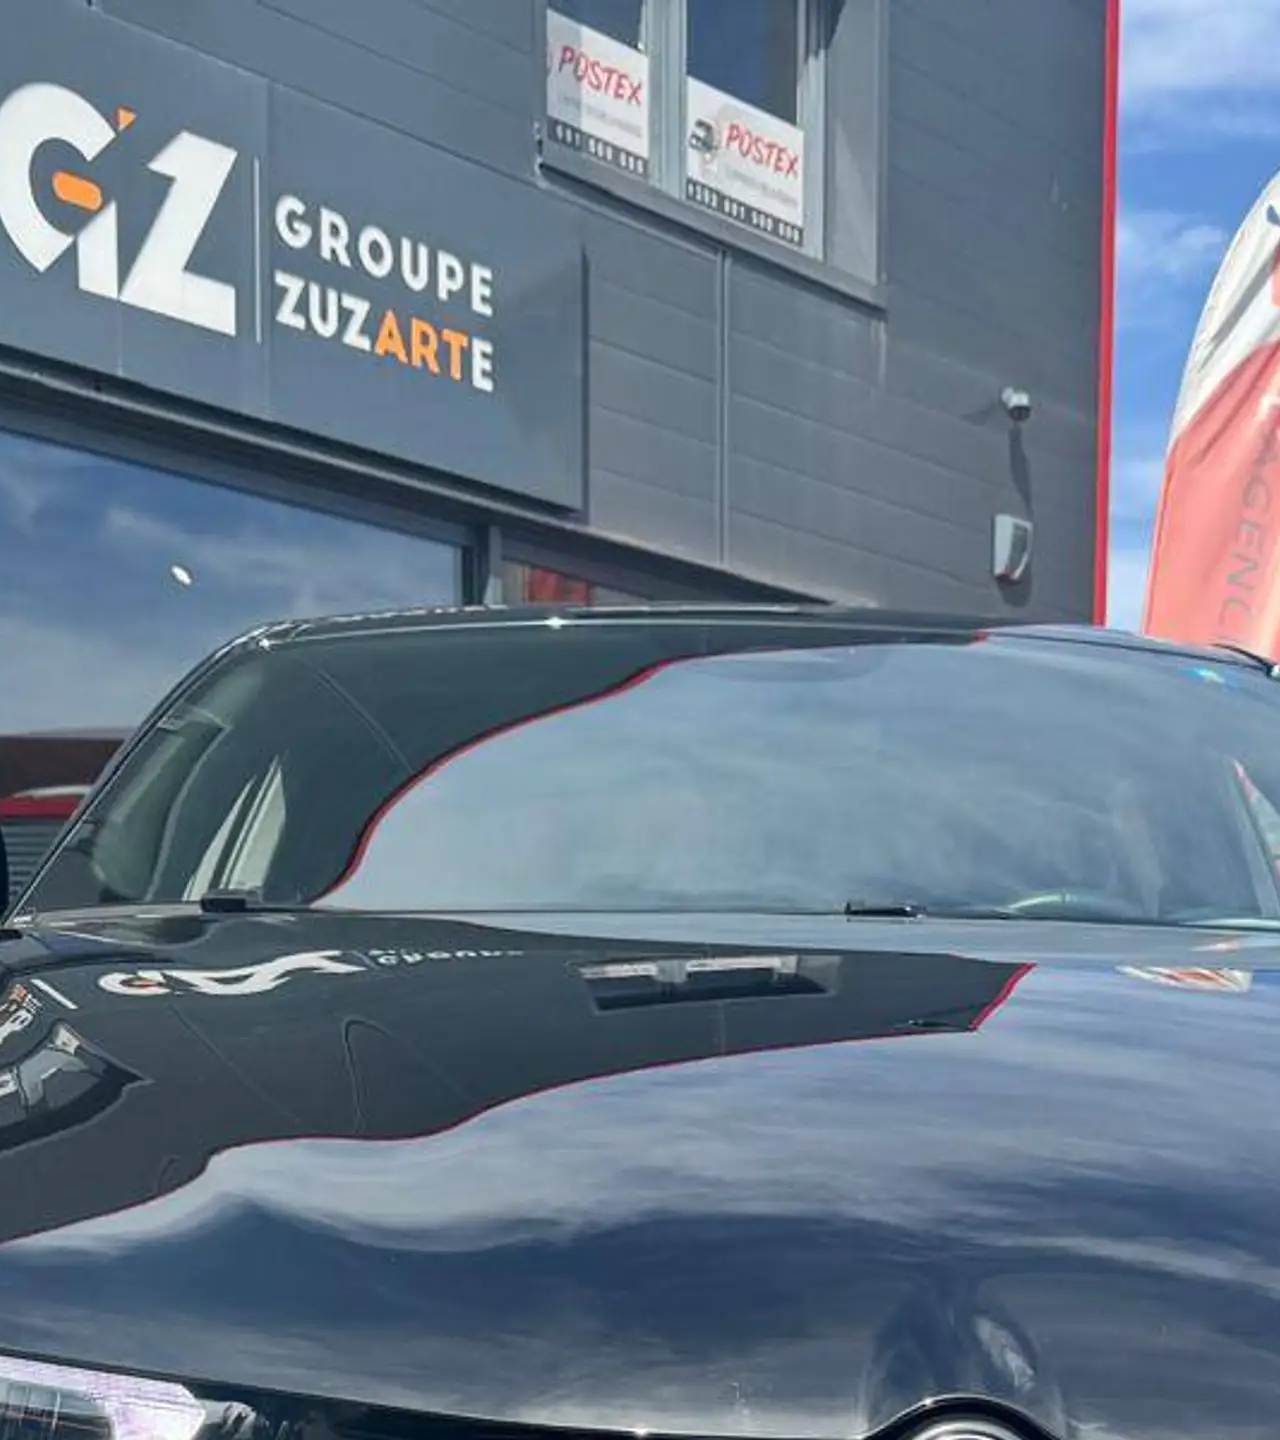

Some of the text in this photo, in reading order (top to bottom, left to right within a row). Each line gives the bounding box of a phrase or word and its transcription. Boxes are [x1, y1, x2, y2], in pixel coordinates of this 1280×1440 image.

[559, 45, 642, 106] POSTEX
[726, 123, 799, 180] POSTEX
[275, 194, 493, 317] GROUPE
[274, 269, 494, 392] ZUZARTE
